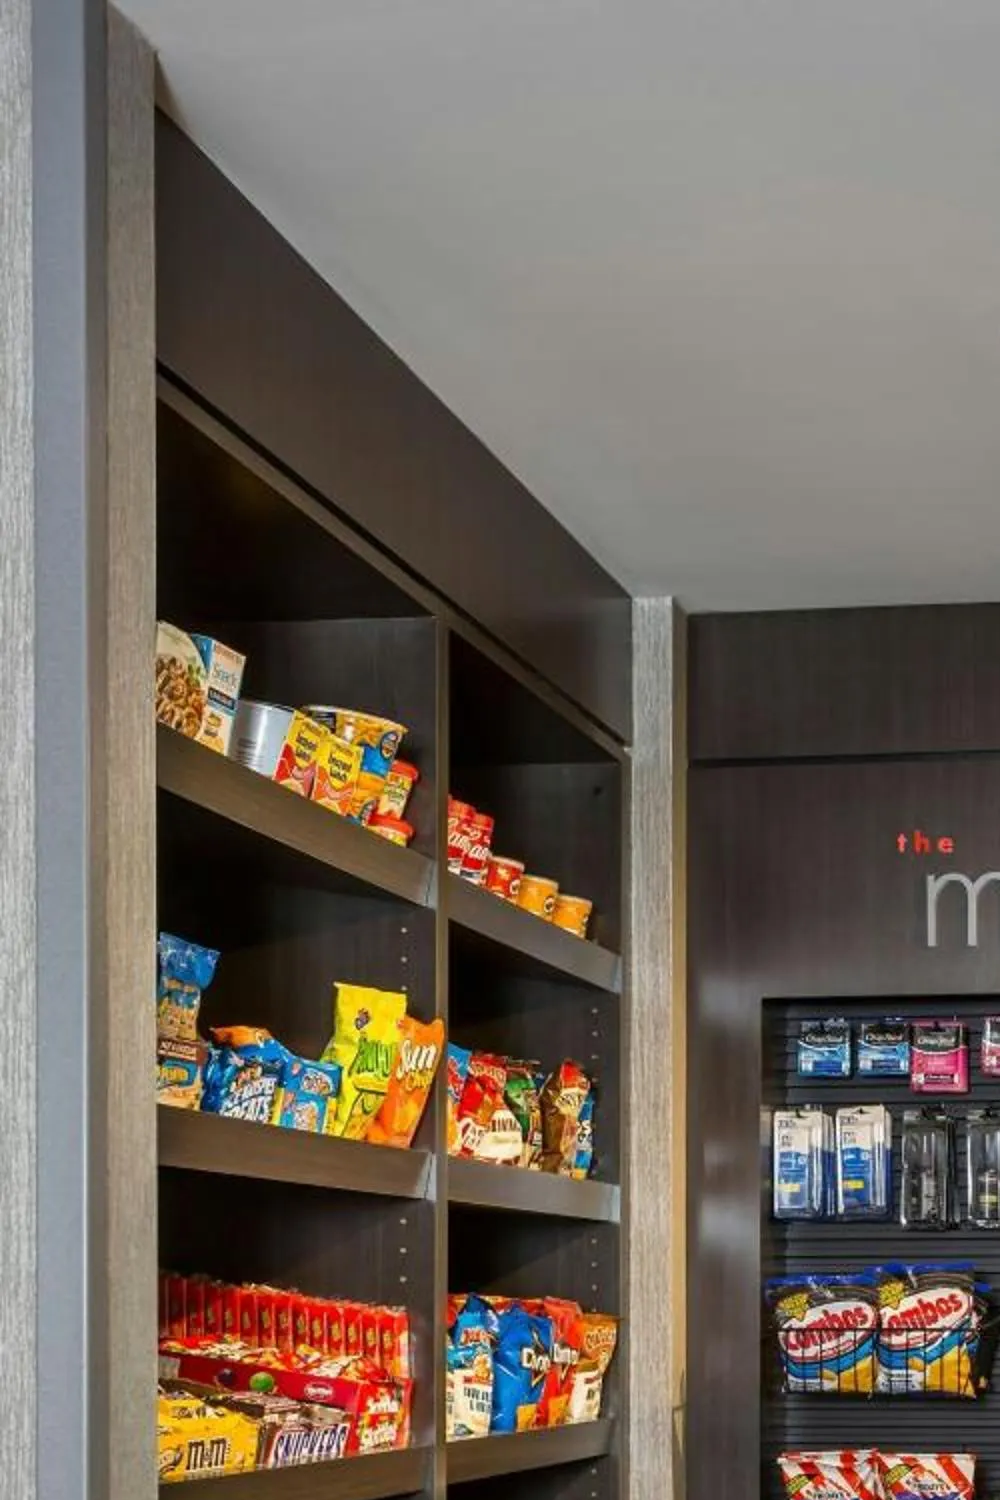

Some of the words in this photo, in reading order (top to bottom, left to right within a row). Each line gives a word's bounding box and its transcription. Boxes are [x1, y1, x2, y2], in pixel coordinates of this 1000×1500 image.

[896, 831, 955, 854] the
[396, 1039, 437, 1079] Sun
[786, 1306, 869, 1351] Combos
